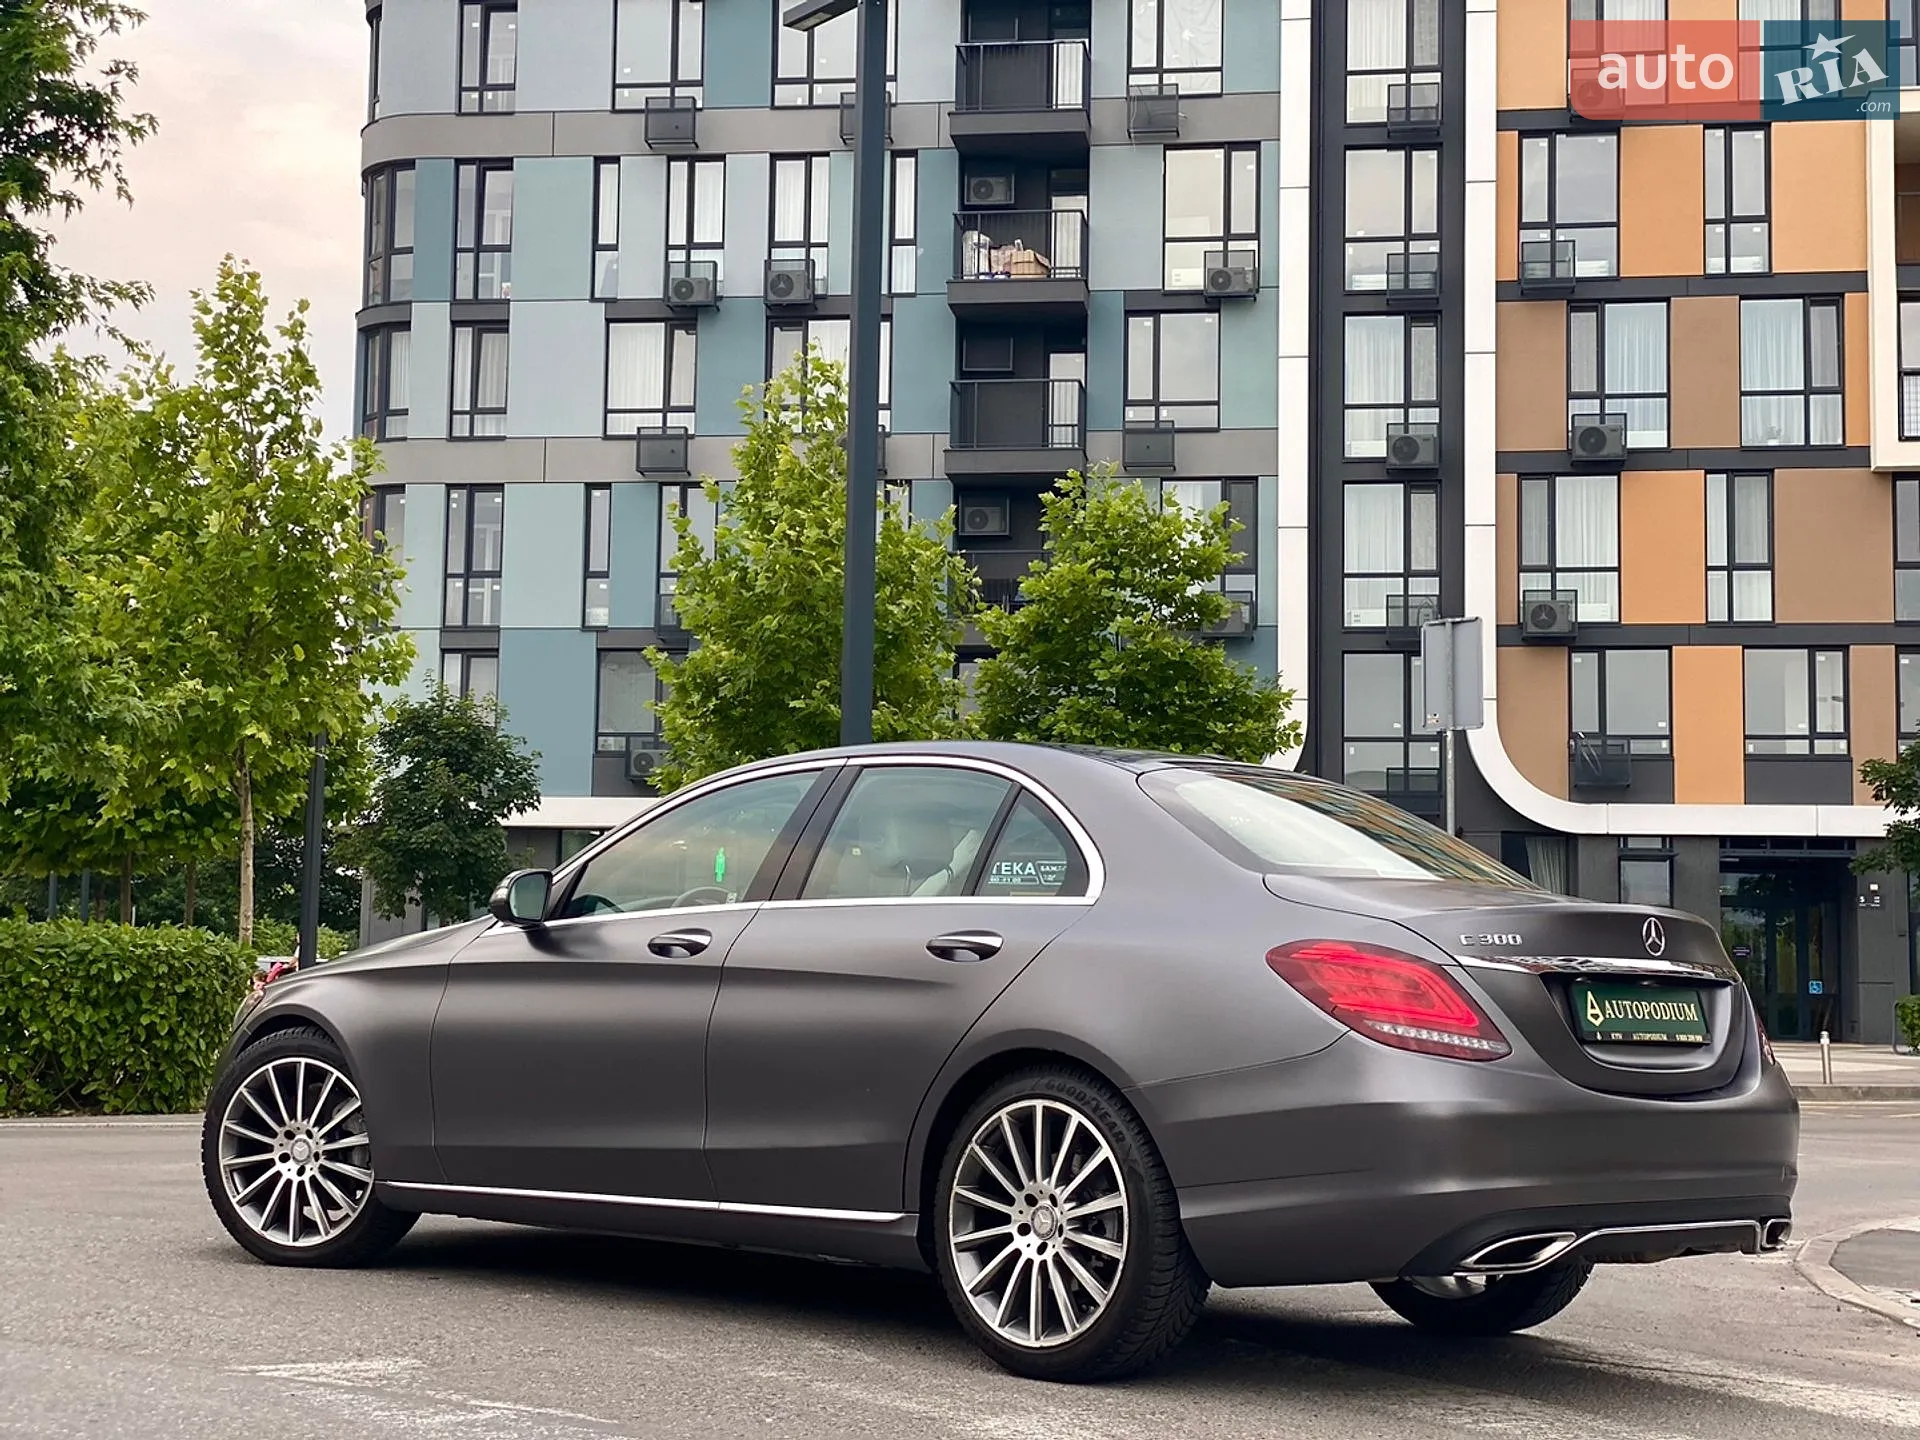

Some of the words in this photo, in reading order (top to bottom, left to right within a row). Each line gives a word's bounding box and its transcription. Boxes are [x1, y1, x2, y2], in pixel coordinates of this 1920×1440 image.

[1460, 934, 1475, 945] C
[1478, 934, 1522, 946] 300
[1605, 999, 1698, 1021] AUTOPODIUM
[1044, 1079, 1126, 1143] GOODYEAR
